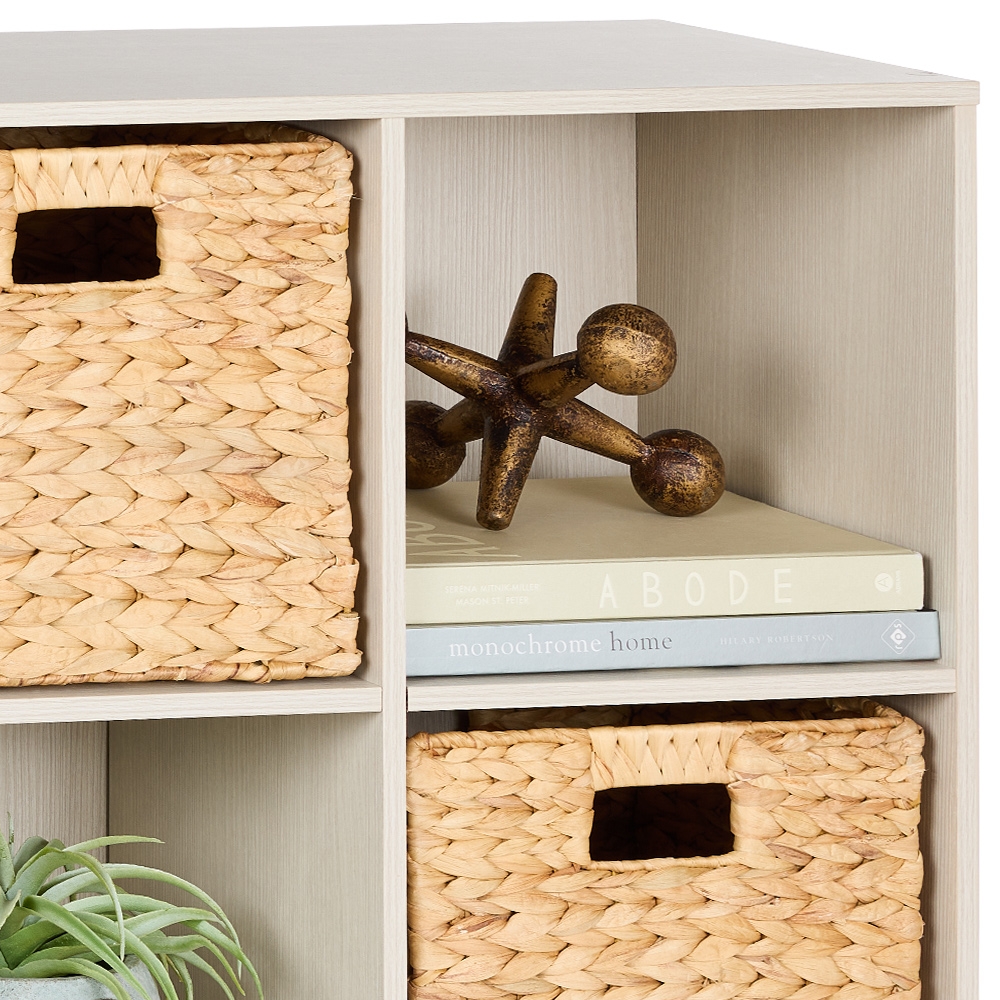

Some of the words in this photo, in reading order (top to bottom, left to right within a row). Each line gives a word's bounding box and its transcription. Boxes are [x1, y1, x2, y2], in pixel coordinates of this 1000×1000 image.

[444, 585, 478, 594] SERENA
[598, 568, 792, 608] ABODE
[455, 597, 489, 606] MASON
[506, 596, 529, 605] PETER
[449, 633, 602, 657] monochrome
[609, 630, 673, 652] home
[720, 636, 761, 646] HILARY
[767, 633, 834, 650] ROBERTSON
